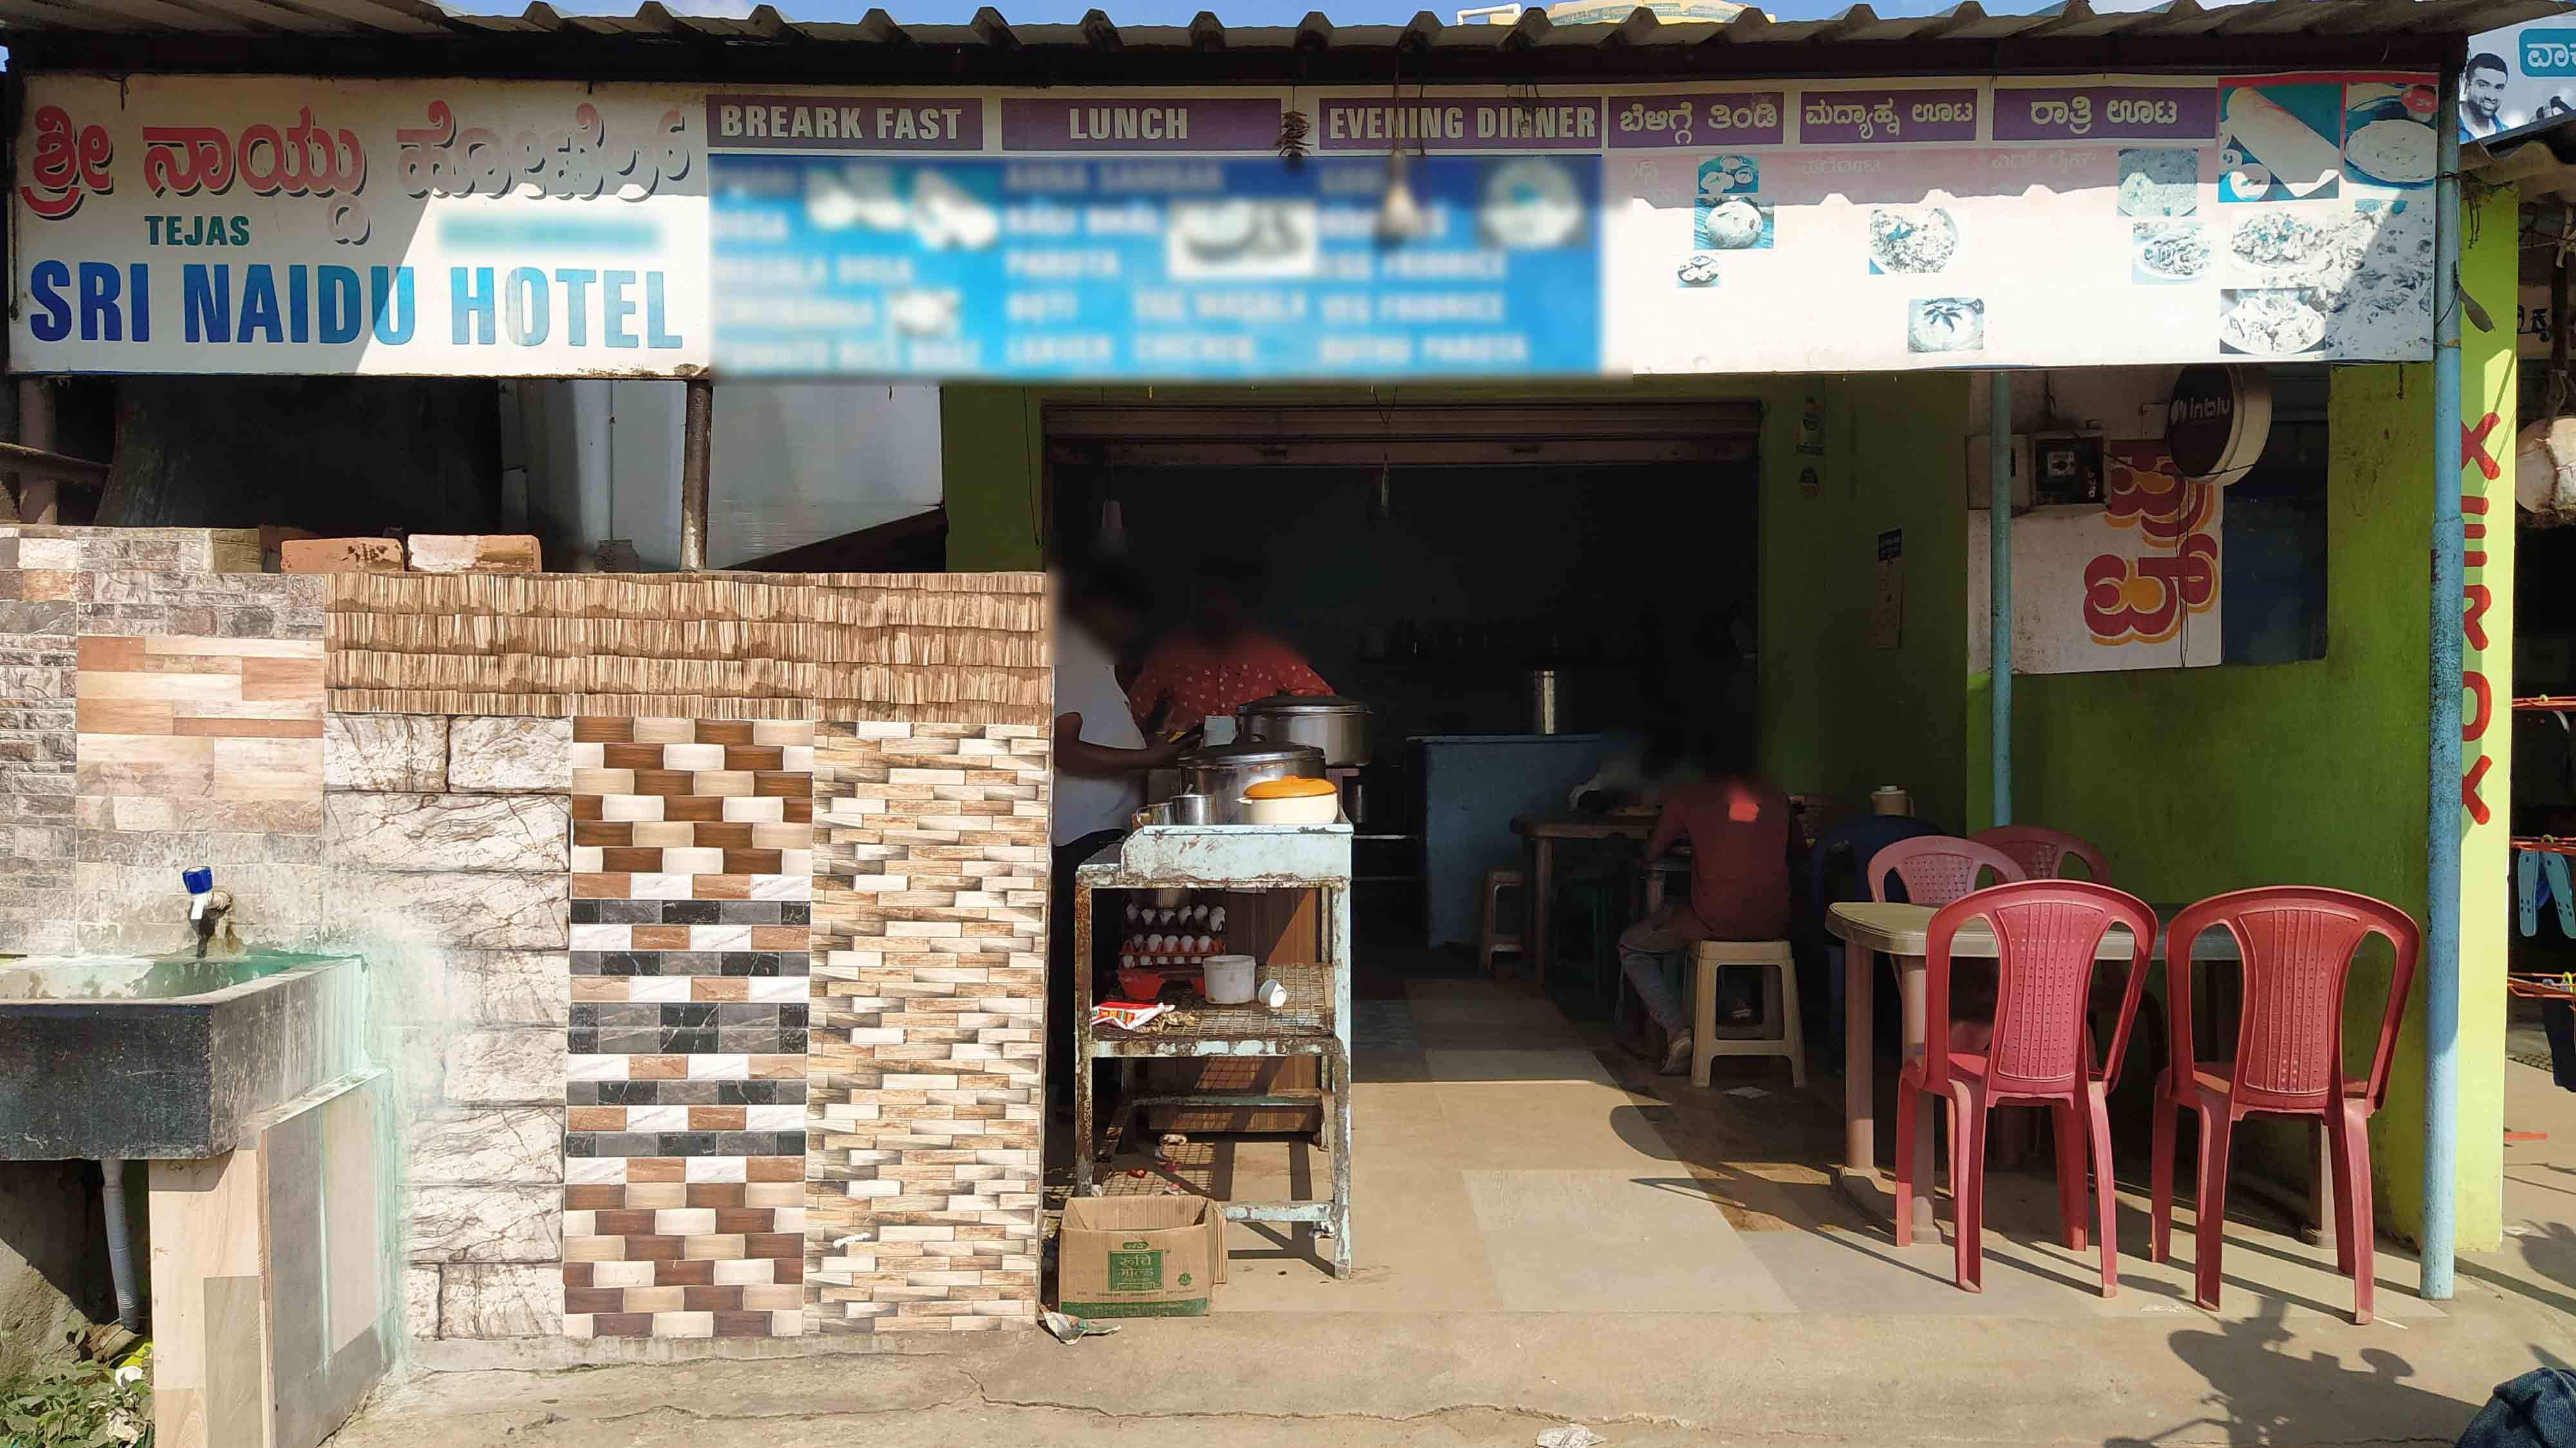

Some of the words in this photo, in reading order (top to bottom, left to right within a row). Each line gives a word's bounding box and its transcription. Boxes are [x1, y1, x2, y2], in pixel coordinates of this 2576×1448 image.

[2527, 43, 2576, 67] ವಾ
[720, 104, 864, 140] BREARK
[876, 108, 962, 140] FAST
[1069, 108, 1188, 140] LUNCH
[1329, 107, 1464, 139] EVENING
[1477, 106, 1596, 138] DINNER
[1708, 103, 1777, 128] ತಿಂಡಿ
[1912, 102, 1973, 122] ಊಟ
[2031, 96, 2092, 134] ರಾತ್ರಿ
[2107, 100, 2177, 124] ಊಟ
[20, 106, 113, 221] ಶ್ರೀ
[144, 216, 249, 246] TEJAS
[30, 260, 149, 343] SRI
[184, 263, 416, 347] NAIDU
[451, 267, 683, 349] HOTEL
